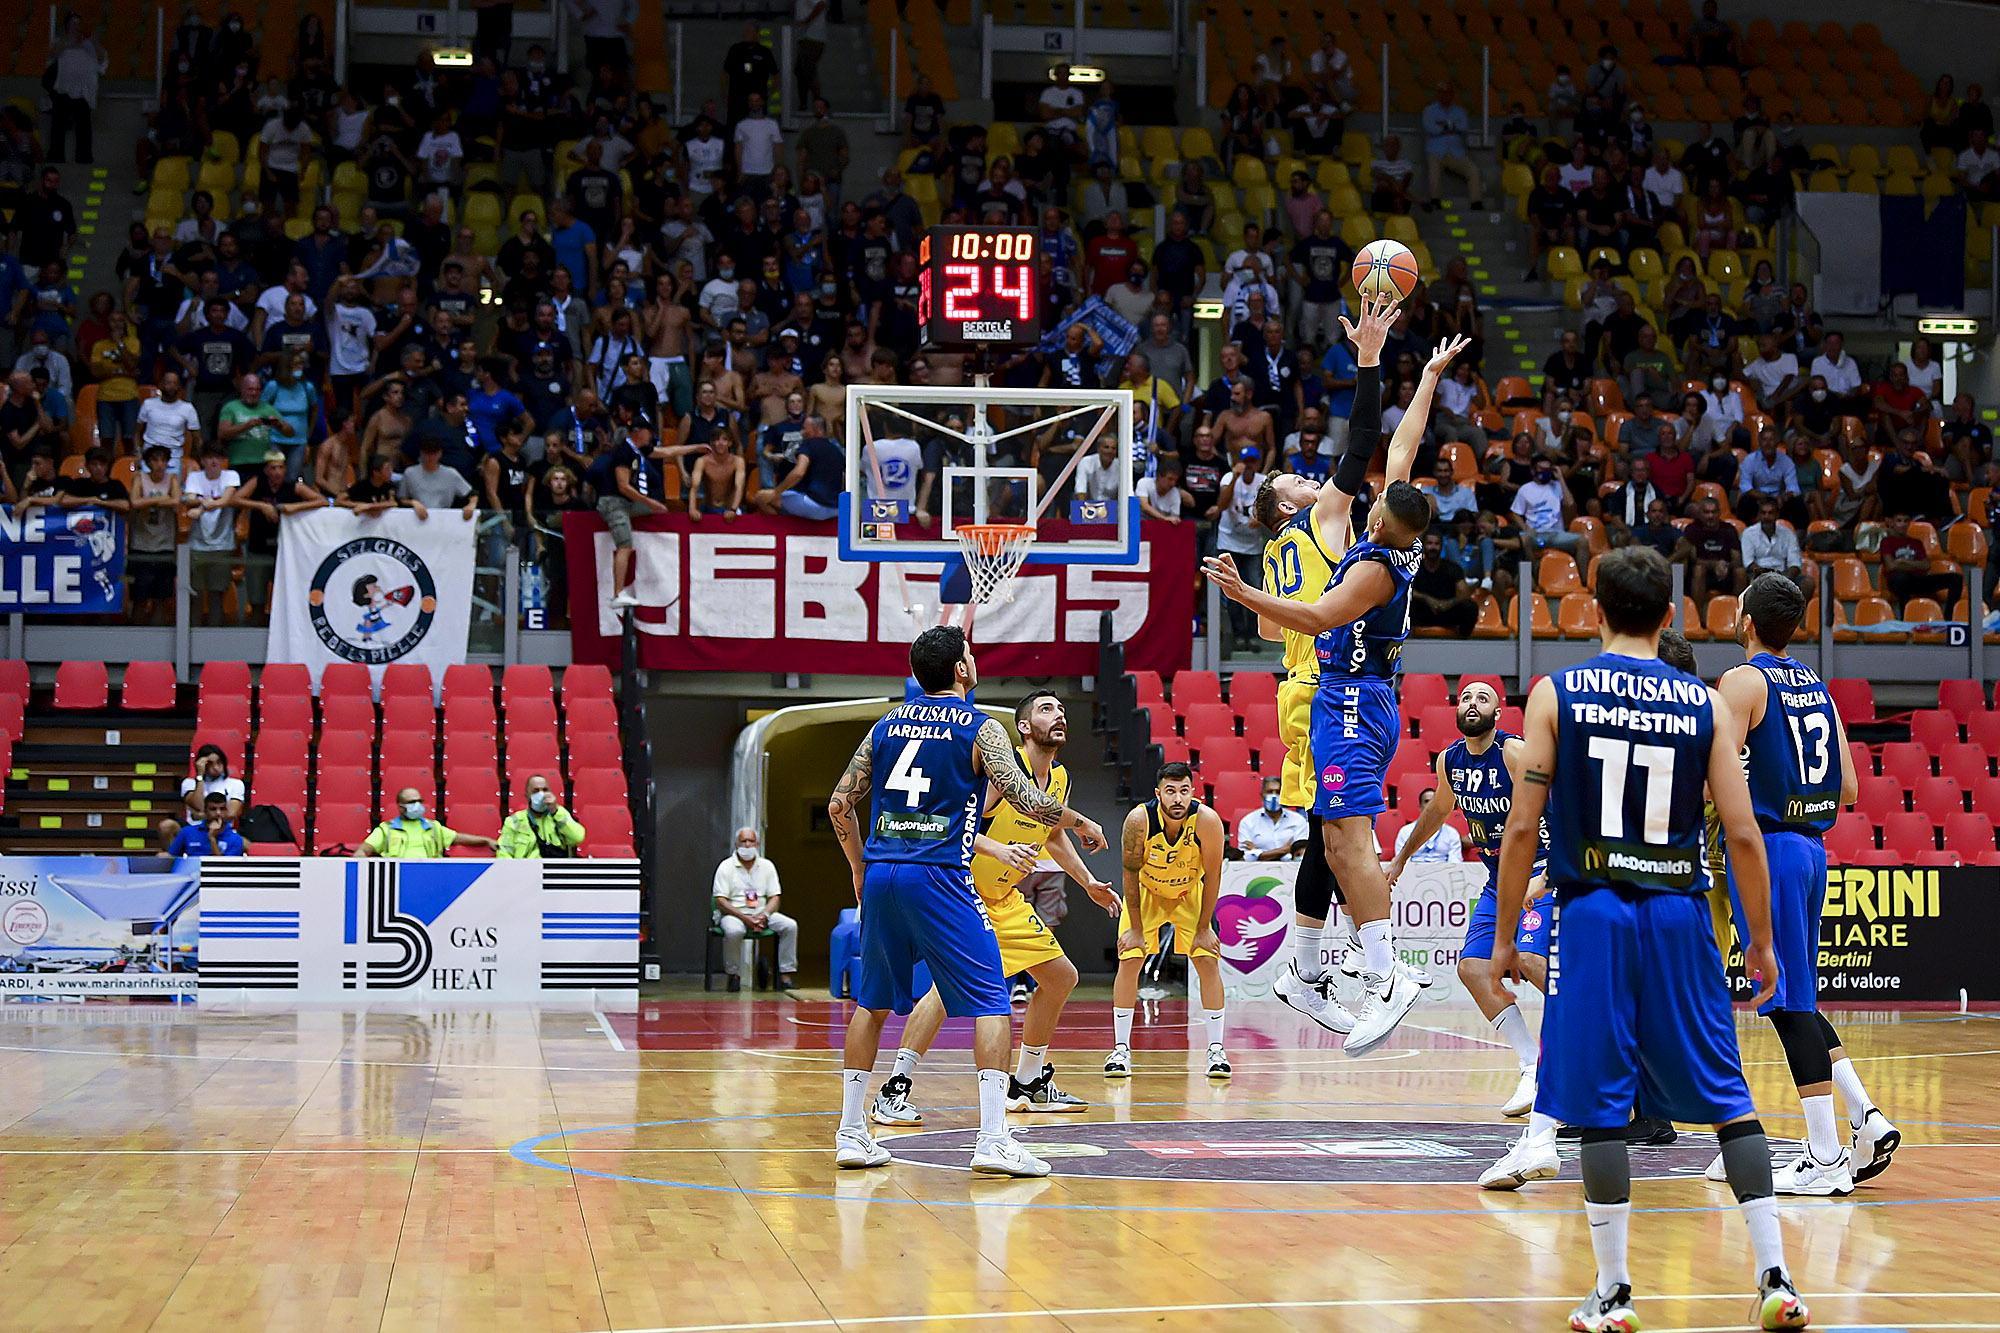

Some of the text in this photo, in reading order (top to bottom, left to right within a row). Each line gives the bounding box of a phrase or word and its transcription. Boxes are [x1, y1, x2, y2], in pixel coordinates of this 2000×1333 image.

[1047, 33, 1060, 48] K
[952, 233, 1032, 260] 10:00
[945, 265, 1029, 319] 24
[374, 540, 422, 572] GIRLS
[528, 609, 544, 629] E
[1950, 626, 1966, 646] D
[1565, 668, 1708, 706] UNICUSANO
[885, 704, 973, 727] UNICUSANO
[1343, 686, 1360, 738] PIELLE
[1571, 703, 1698, 736] TEMPESTINI
[887, 724, 953, 741] IARDELLA
[1788, 712, 1831, 785] 13
[884, 739, 932, 808] 4
[1323, 773, 1344, 784] SUD
[1466, 768, 1484, 793] 19
[1588, 736, 1676, 845] 11
[1607, 852, 1693, 875] McDonald's
[1522, 915, 1541, 926] SUD
[450, 926, 498, 948] GAS
[480, 954, 497, 963] and
[1548, 905, 1561, 996] PIELLE
[1816, 951, 1873, 967] Bertini
[37, 979, 45, 988] 4
[431, 968, 498, 990] HEAT
[1832, 973, 1847, 989] di
[1850, 973, 1901, 989] valore
